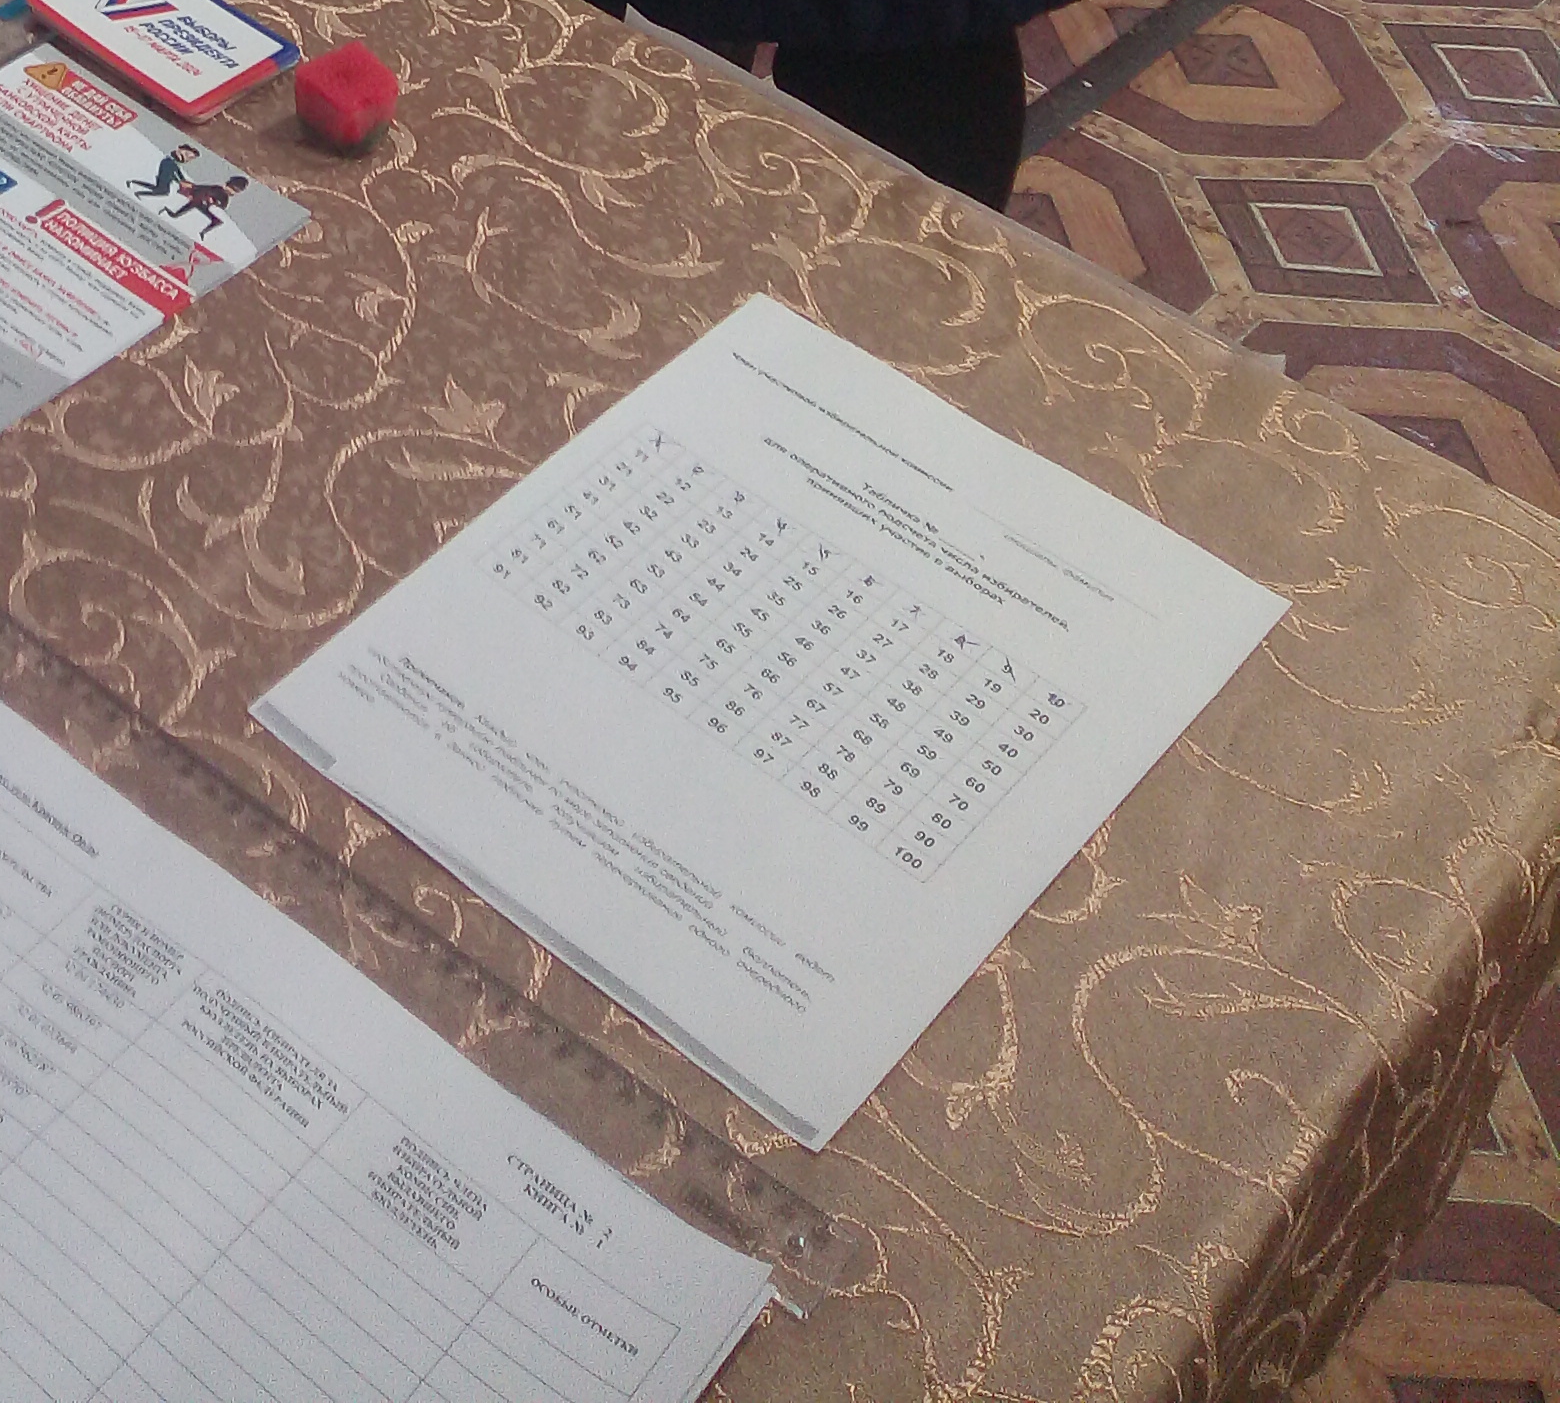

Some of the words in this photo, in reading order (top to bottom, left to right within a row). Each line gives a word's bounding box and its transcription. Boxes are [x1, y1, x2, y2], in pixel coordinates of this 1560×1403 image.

[139, 23, 193, 54] РОССИИ
[158, 20, 239, 68] ПРЕЗИДЕНТА
[177, 16, 236, 50] ВЫБОРЫ
[14, 111, 72, 152] СМАРТФОНА
[58, 127, 91, 150] КАРТЫ
[45, 220, 127, 279] НАПОМИНАЕТ
[57, 212, 118, 256] ПОЛИЦИЯ
[116, 254, 178, 300] КУЗБАССА
[764, 438, 787, 453] для
[790, 454, 875, 509] оперативного
[878, 509, 936, 548] подсчета
[941, 547, 979, 574] числа
[982, 574, 1067, 629] избирателей,
[807, 478, 876, 524] принявших
[880, 524, 930, 558] участие
[945, 566, 1004, 604] выборах
[863, 483, 920, 523] Табличка
[926, 522, 938, 533] №
[751, 609, 769, 621] 45
[795, 638, 814, 650] 46
[841, 668, 860, 679] 47
[887, 699, 906, 712] 48
[934, 730, 953, 742] 49
[982, 760, 1002, 775] 50
[767, 592, 785, 606] 35
[812, 621, 830, 634] 36
[856, 650, 876, 662] 37
[902, 680, 922, 695] 38
[950, 711, 970, 726] 39
[999, 744, 1018, 757] 40
[784, 576, 802, 590] 25
[828, 605, 846, 619] 26
[873, 634, 893, 647] 27
[919, 664, 938, 679] 28
[966, 694, 985, 709] 29
[1014, 726, 1034, 740] 30
[803, 562, 818, 575] 15
[847, 590, 863, 603] 16
[892, 619, 909, 631] 17
[938, 649, 954, 663] 18
[985, 679, 1001, 692] 19
[1029, 709, 1049, 724] 20
[681, 671, 698, 686] 85
[725, 701, 745, 716] 86
[771, 732, 792, 745] 87
[818, 763, 837, 779] 88
[866, 797, 886, 813] 89
[915, 831, 935, 847] 90
[700, 654, 718, 669] 75
[744, 684, 762, 699] 76
[790, 715, 809, 729] 77
[837, 745, 855, 762] 78
[884, 779, 903, 795] 79
[932, 813, 951, 829] 80
[716, 639, 734, 653] 65
[761, 669, 780, 683] 66
[807, 699, 826, 712] 67
[853, 730, 872, 745] 68
[901, 762, 920, 777] 69
[949, 793, 968, 810] 70
[733, 623, 752, 637] 55
[778, 652, 797, 666] 56
[823, 683, 843, 695] 57
[870, 713, 888, 728] 58
[917, 745, 937, 760] 59
[966, 777, 985, 793] 60
[663, 688, 681, 702] 95
[708, 718, 727, 733] 96
[754, 749, 774, 762] 97
[801, 781, 820, 797] 98
[849, 815, 868, 831] 99
[896, 847, 922, 868] 100
[508, 1156, 576, 1213] СТРАНИЦА
[604, 1228, 612, 1239] 2
[524, 1184, 567, 1223] КНИГА
[597, 1239, 603, 1248] 1
[531, 1279, 577, 1316] ОСОБЫЕ
[581, 1315, 638, 1356] ОТМЕТКИ
